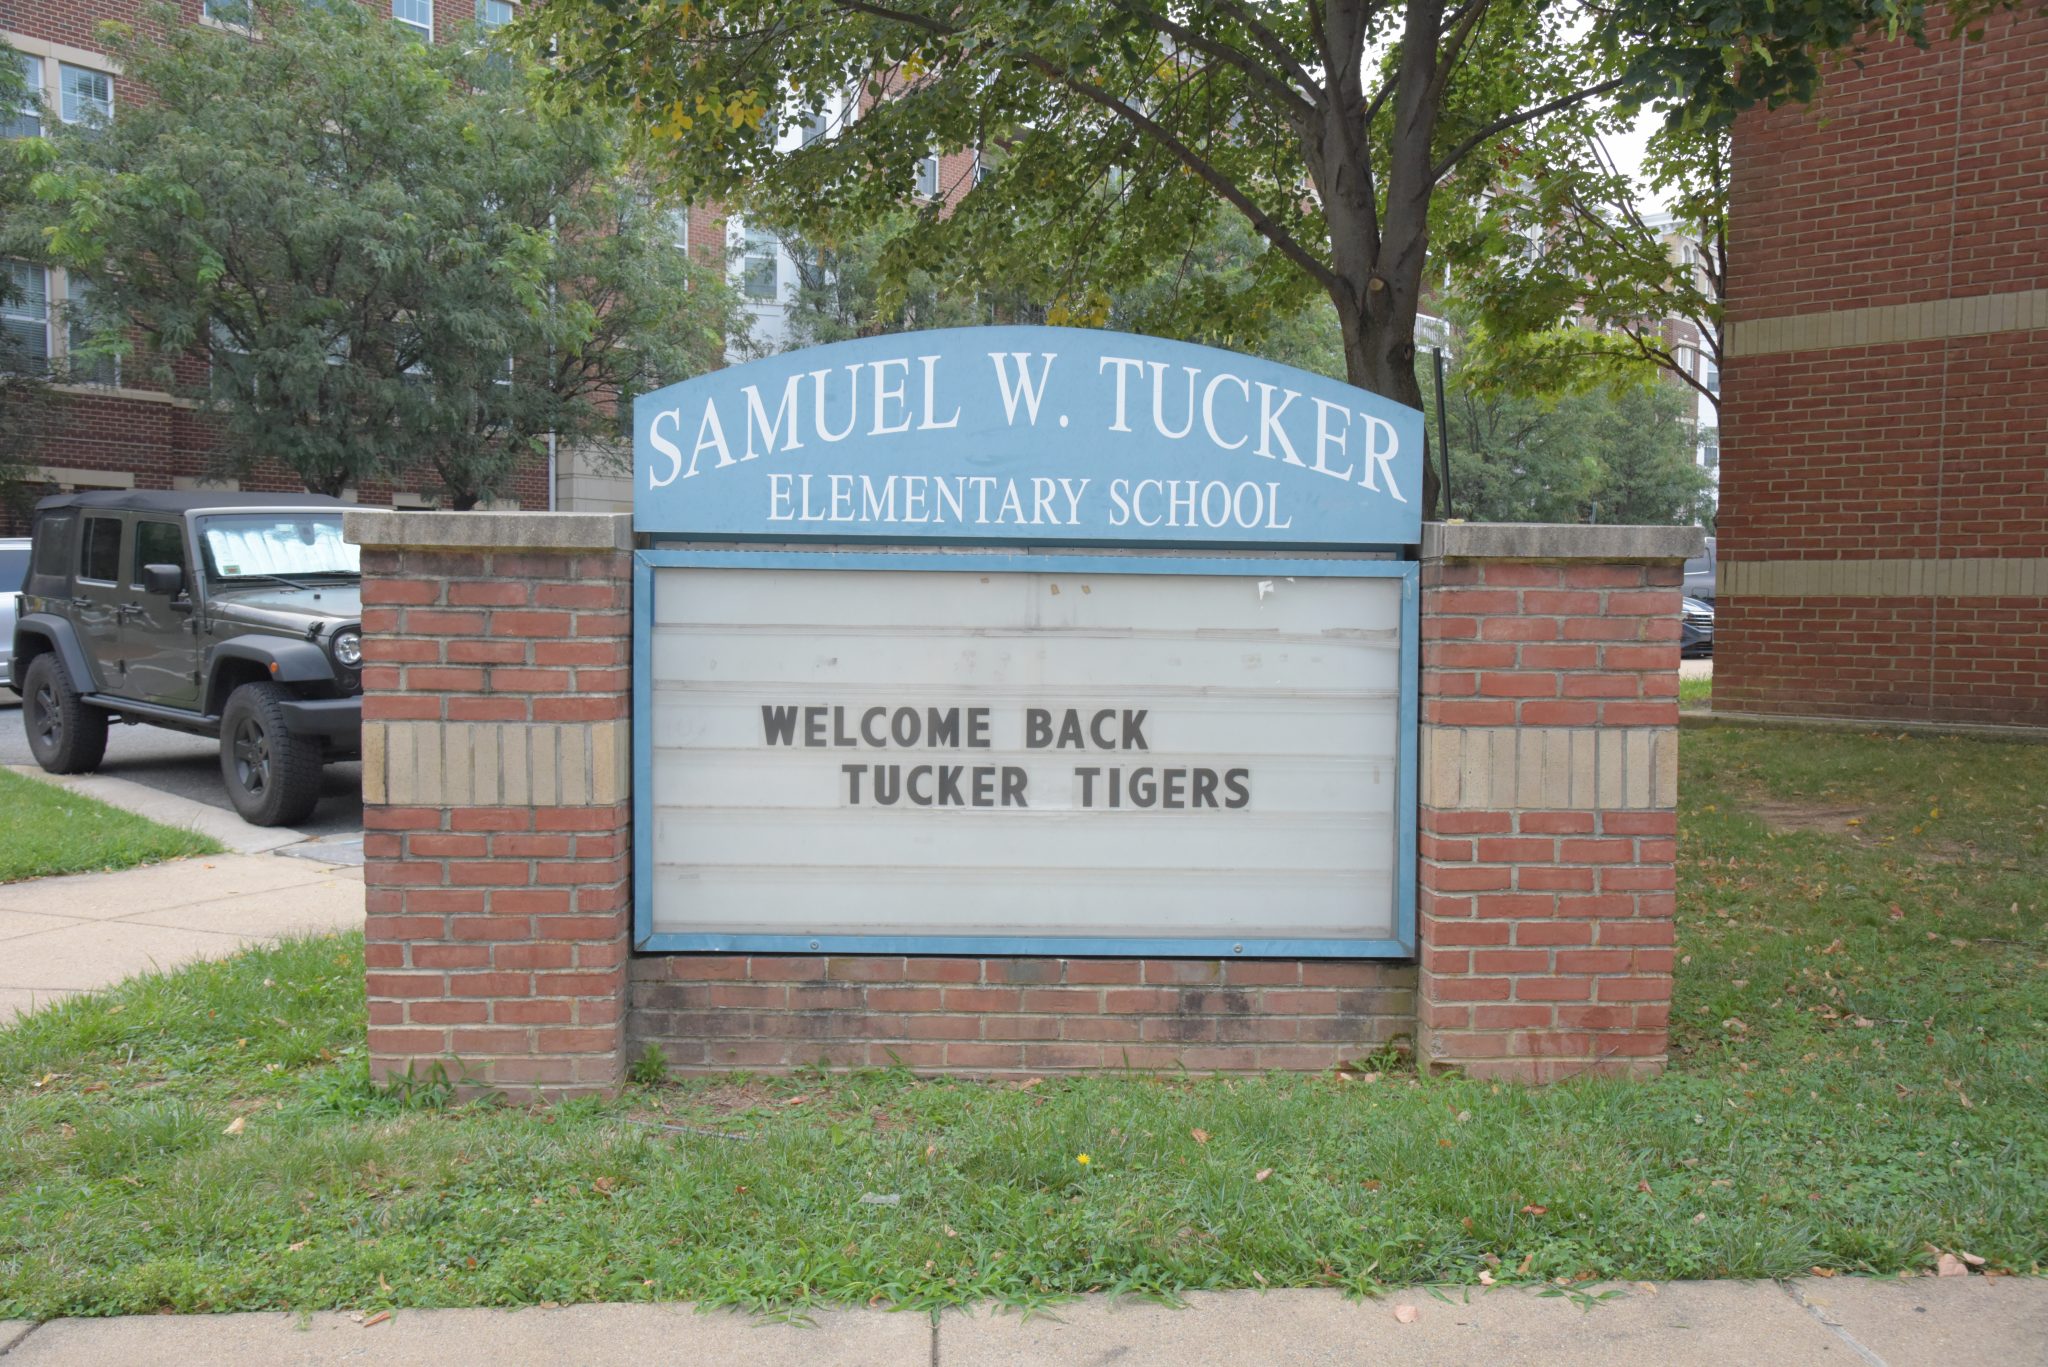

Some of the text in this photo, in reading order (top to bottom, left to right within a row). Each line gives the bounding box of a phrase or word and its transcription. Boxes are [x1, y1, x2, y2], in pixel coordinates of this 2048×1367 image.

[650, 352, 1407, 503] SAMUEL W. TUCKER
[766, 473, 1292, 529] ELEMENTARY SCHOOL
[761, 705, 1149, 750] WELCOME BACK
[842, 763, 1250, 809] TUCKER TIGERS
